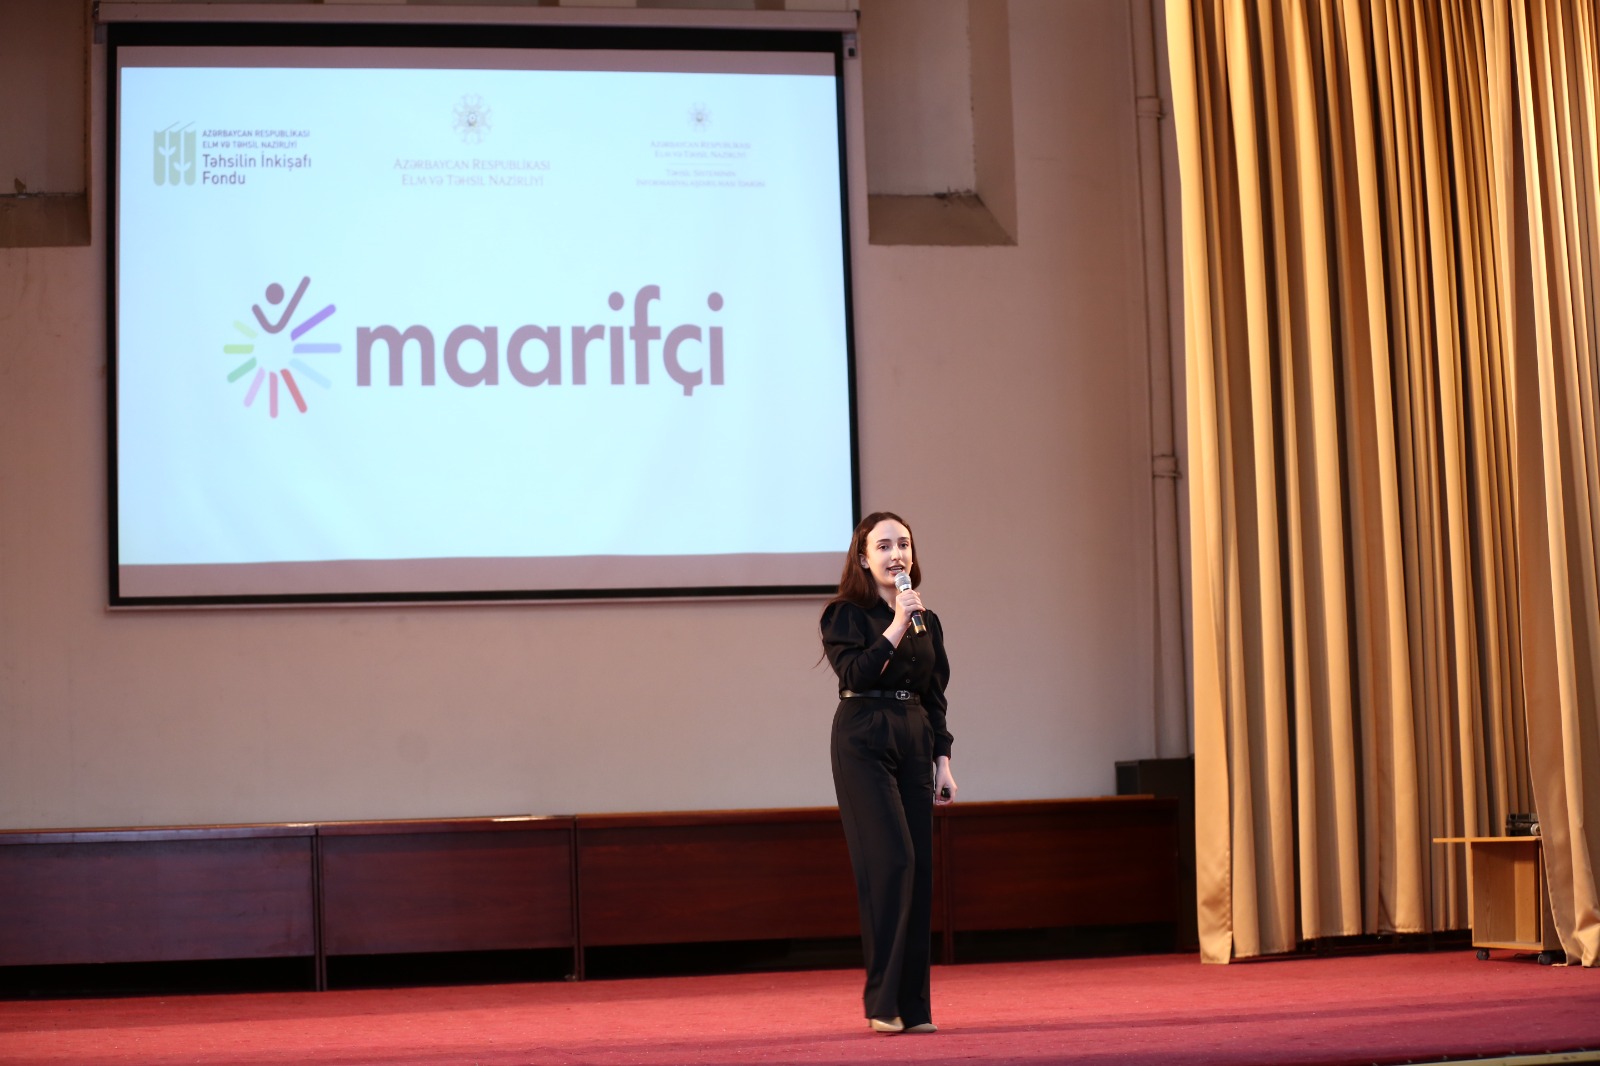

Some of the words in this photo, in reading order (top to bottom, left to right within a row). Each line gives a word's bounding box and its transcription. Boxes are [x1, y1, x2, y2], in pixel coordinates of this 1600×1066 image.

[202, 129, 253, 138] AZƏRBAYCAN
[202, 140, 219, 149] ELM
[202, 153, 257, 168] Təhsilin
[261, 150, 312, 172] İnkişafı
[202, 170, 246, 185] Fondu
[356, 284, 725, 397] maarifçi
